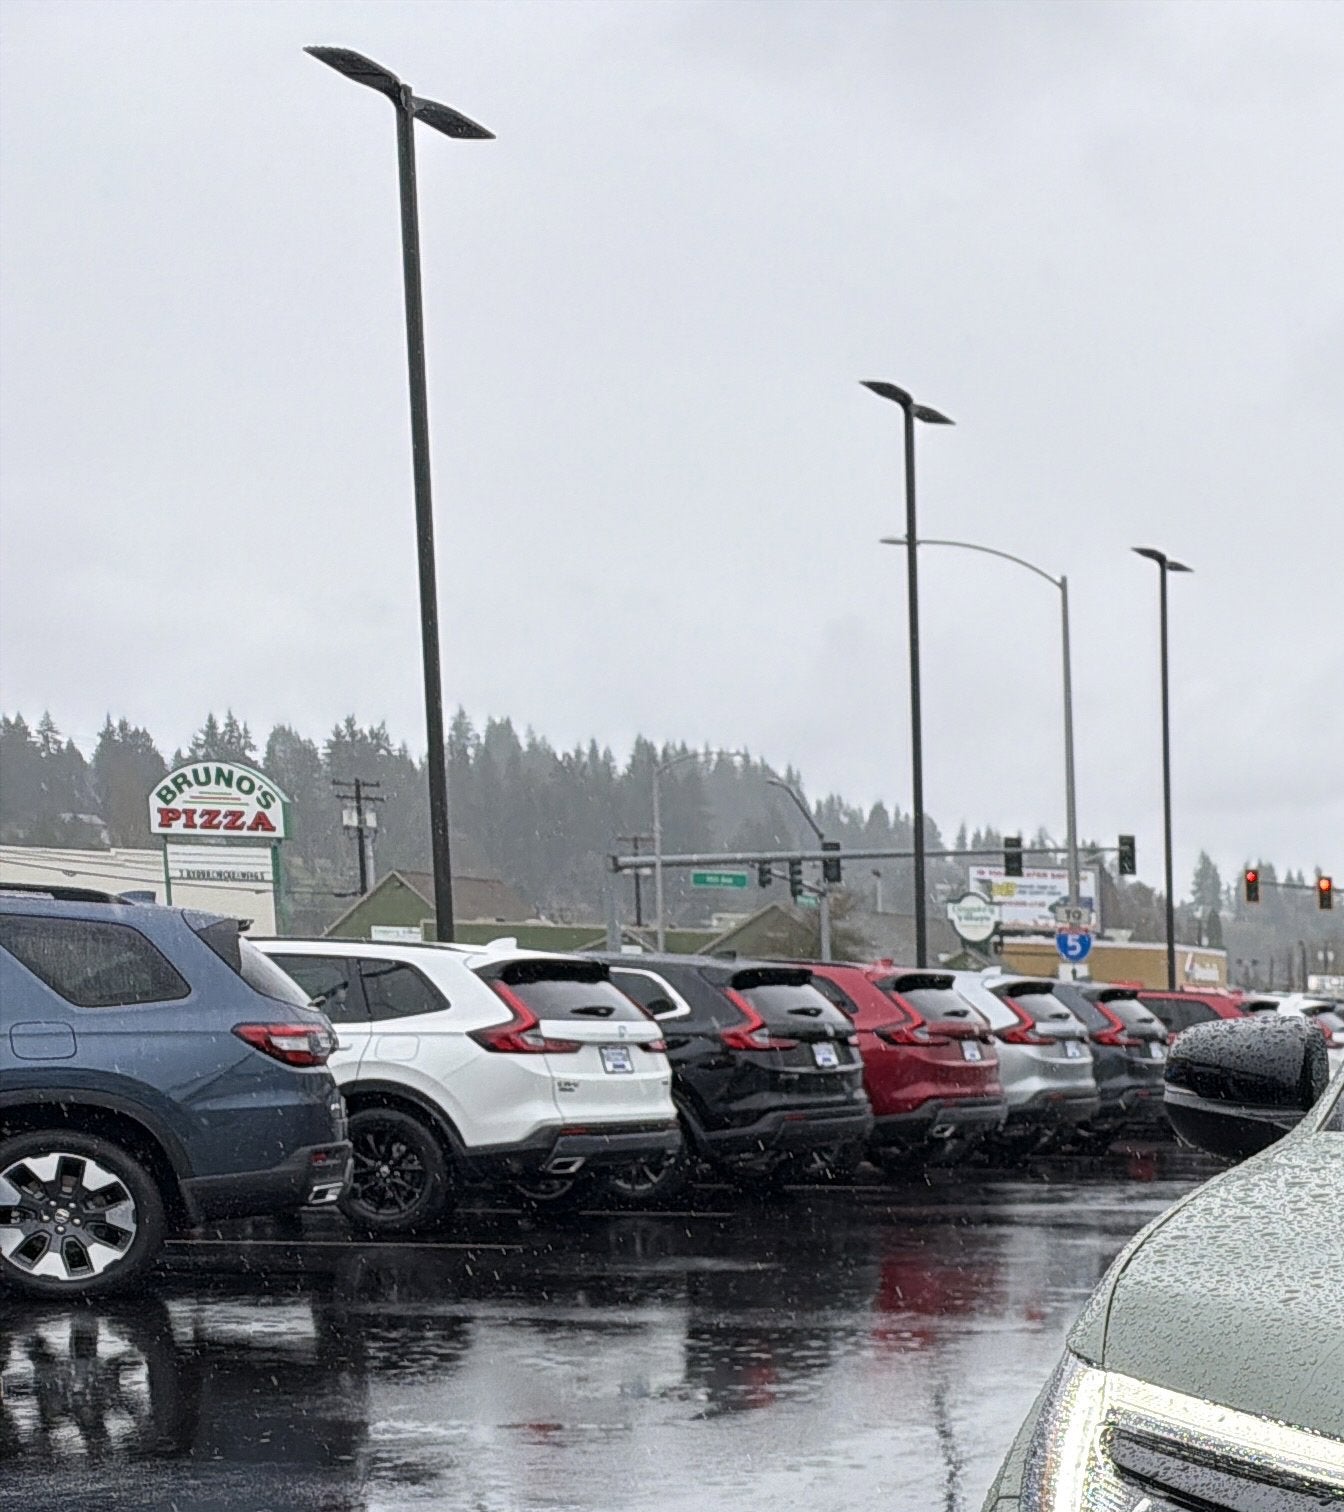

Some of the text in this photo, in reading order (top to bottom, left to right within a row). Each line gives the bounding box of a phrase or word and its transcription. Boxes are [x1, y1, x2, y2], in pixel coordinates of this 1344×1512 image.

[155, 766, 276, 810] BRUNO'S
[156, 806, 277, 832] PIZZA
[1067, 934, 1082, 957] 5
